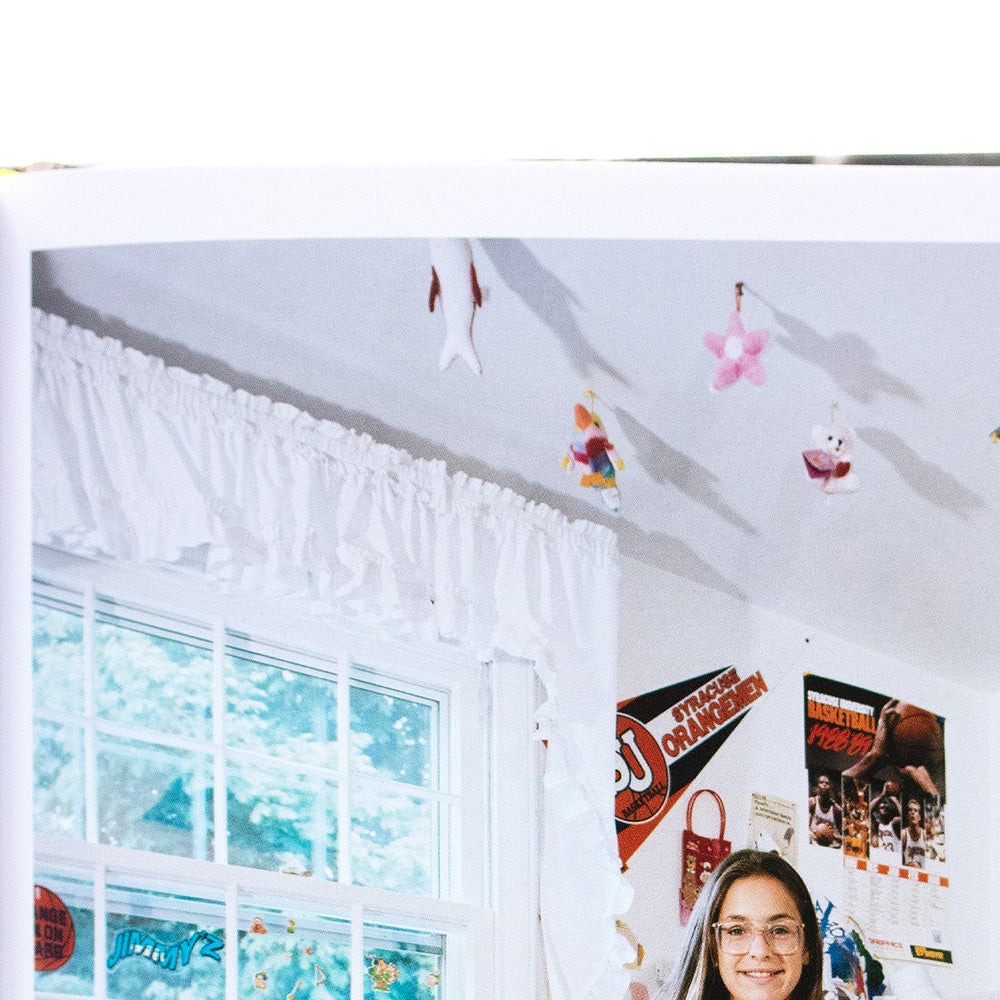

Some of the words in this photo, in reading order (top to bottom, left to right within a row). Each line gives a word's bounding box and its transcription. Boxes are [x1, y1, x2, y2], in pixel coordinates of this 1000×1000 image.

[661, 670, 769, 757] ORANGEMEN
[672, 667, 741, 722] SYRACUSE
[807, 699, 877, 734] BASKETBALL
